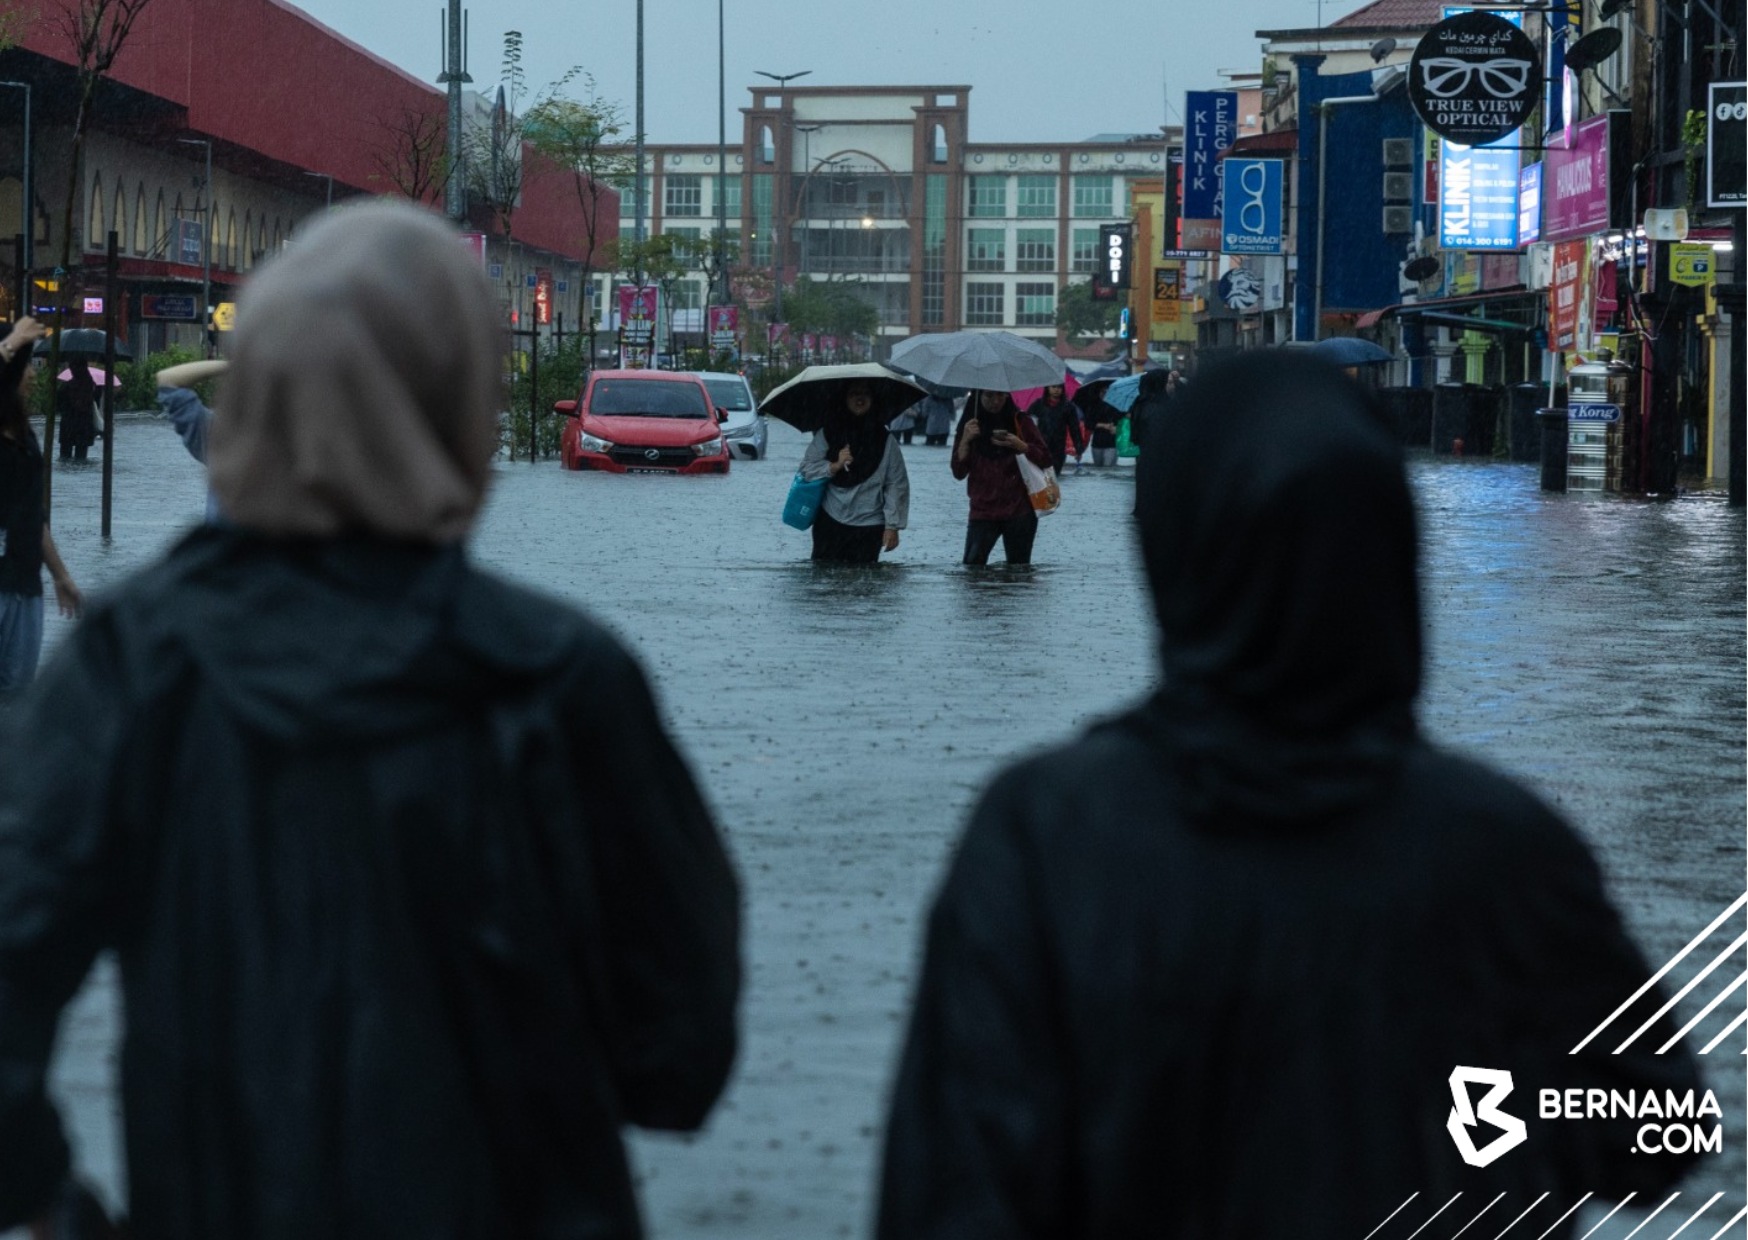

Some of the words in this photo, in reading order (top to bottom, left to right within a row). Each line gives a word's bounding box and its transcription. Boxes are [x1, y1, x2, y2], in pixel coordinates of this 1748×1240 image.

[1425, 99, 1474, 111] TRUE
[1478, 100, 1525, 112] VIEW
[1436, 113, 1513, 125] OPTICAL
[1193, 110, 1207, 191] KLINIK
[1444, 158, 1471, 235] KLINIK
[1239, 235, 1278, 245] OSMADI
[1456, 238, 1491, 246] 014-300
[1109, 235, 1122, 283] DOBI
[1158, 283, 1178, 299] 24
[1578, 405, 1615, 420] Kong
